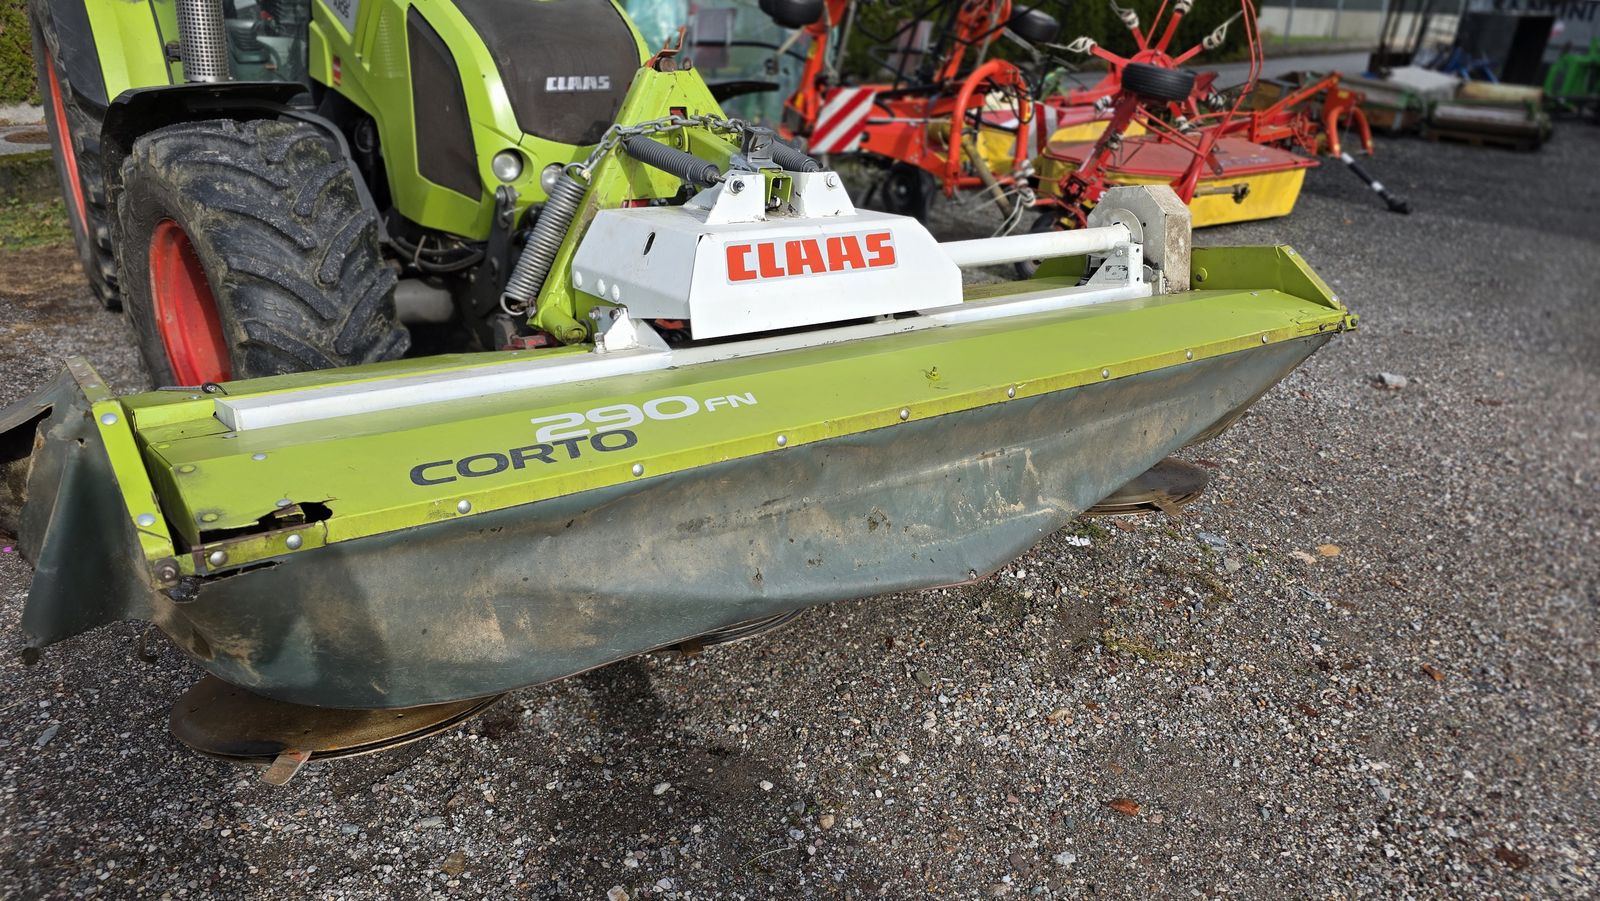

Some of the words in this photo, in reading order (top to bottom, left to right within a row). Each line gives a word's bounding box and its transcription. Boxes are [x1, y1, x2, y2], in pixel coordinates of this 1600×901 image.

[545, 75, 610, 92] CLAAS
[726, 232, 896, 282] CLAAS
[530, 395, 700, 443] 290
[704, 392, 758, 412] FN
[409, 429, 639, 486] CORTO
